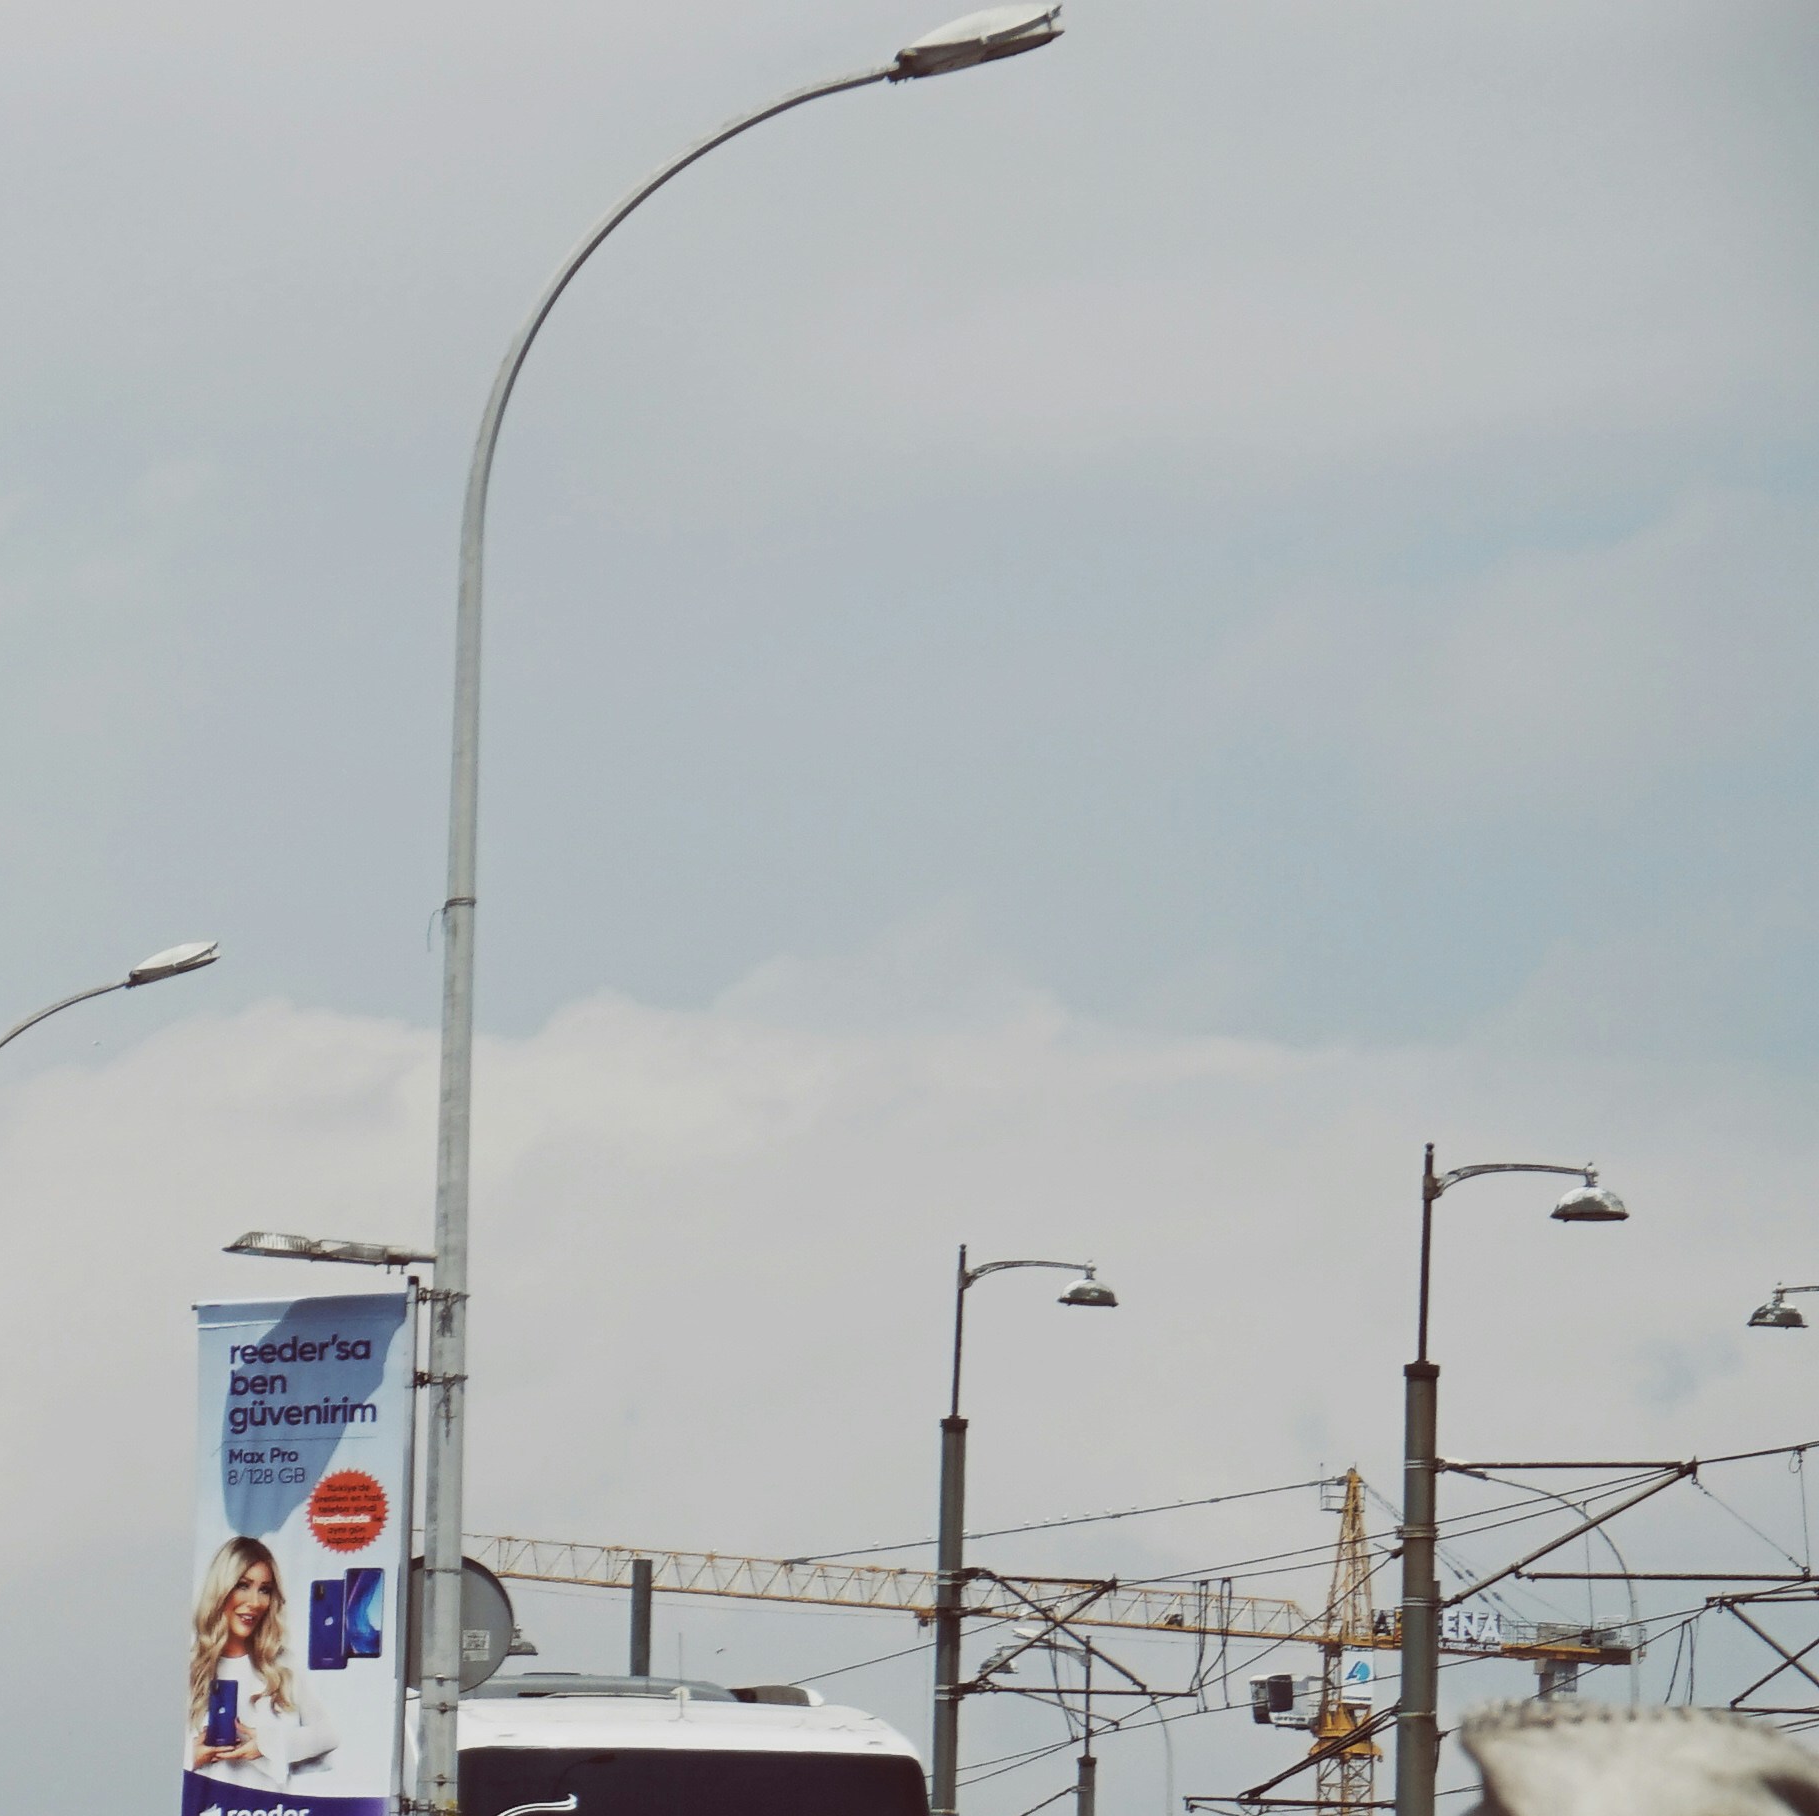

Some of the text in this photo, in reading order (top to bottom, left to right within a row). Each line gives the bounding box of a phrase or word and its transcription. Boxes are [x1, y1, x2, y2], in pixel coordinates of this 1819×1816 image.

[230, 1334, 371, 1364] reeder'sa
[230, 1370, 287, 1395] ben
[229, 1396, 377, 1434] güvenirim
[229, 1447, 299, 1464] Max Pro
[228, 1467, 305, 1485] 8/128 GB
